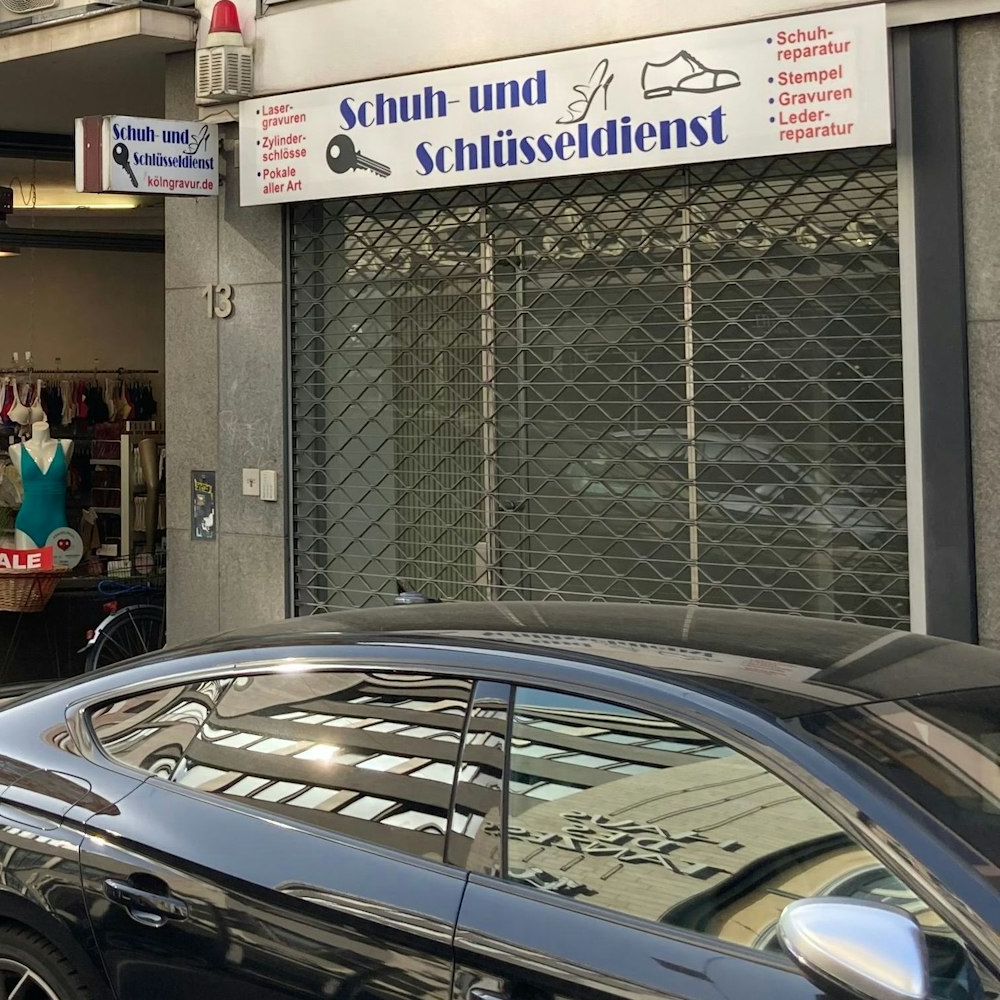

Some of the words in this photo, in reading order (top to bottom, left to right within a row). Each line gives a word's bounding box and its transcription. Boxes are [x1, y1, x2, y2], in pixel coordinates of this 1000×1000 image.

[777, 26, 833, 45] Schuh-
[777, 41, 851, 62] reparatur
[778, 64, 843, 86] Stempel
[339, 86, 460, 131] Schuh-
[469, 70, 547, 114] und
[778, 87, 853, 106] Gravuren
[262, 104, 293, 116] Laser-
[779, 108, 831, 125] Leder-
[262, 113, 306, 131] gravuren
[112, 123, 160, 143] Schuh-
[162, 129, 189, 144] und
[262, 133, 306, 150] Zylinder-
[415, 105, 729, 176] Schlüsseldienst
[779, 122, 854, 143] reparatur
[133, 151, 214, 170] Schlüsseldienst
[262, 147, 307, 162] schlösse
[263, 166, 296, 180] Pokale
[147, 175, 214, 191] kölngravur.de
[263, 183, 284, 194] aller
[286, 179, 302, 191] Art
[201, 282, 233, 319] 13
